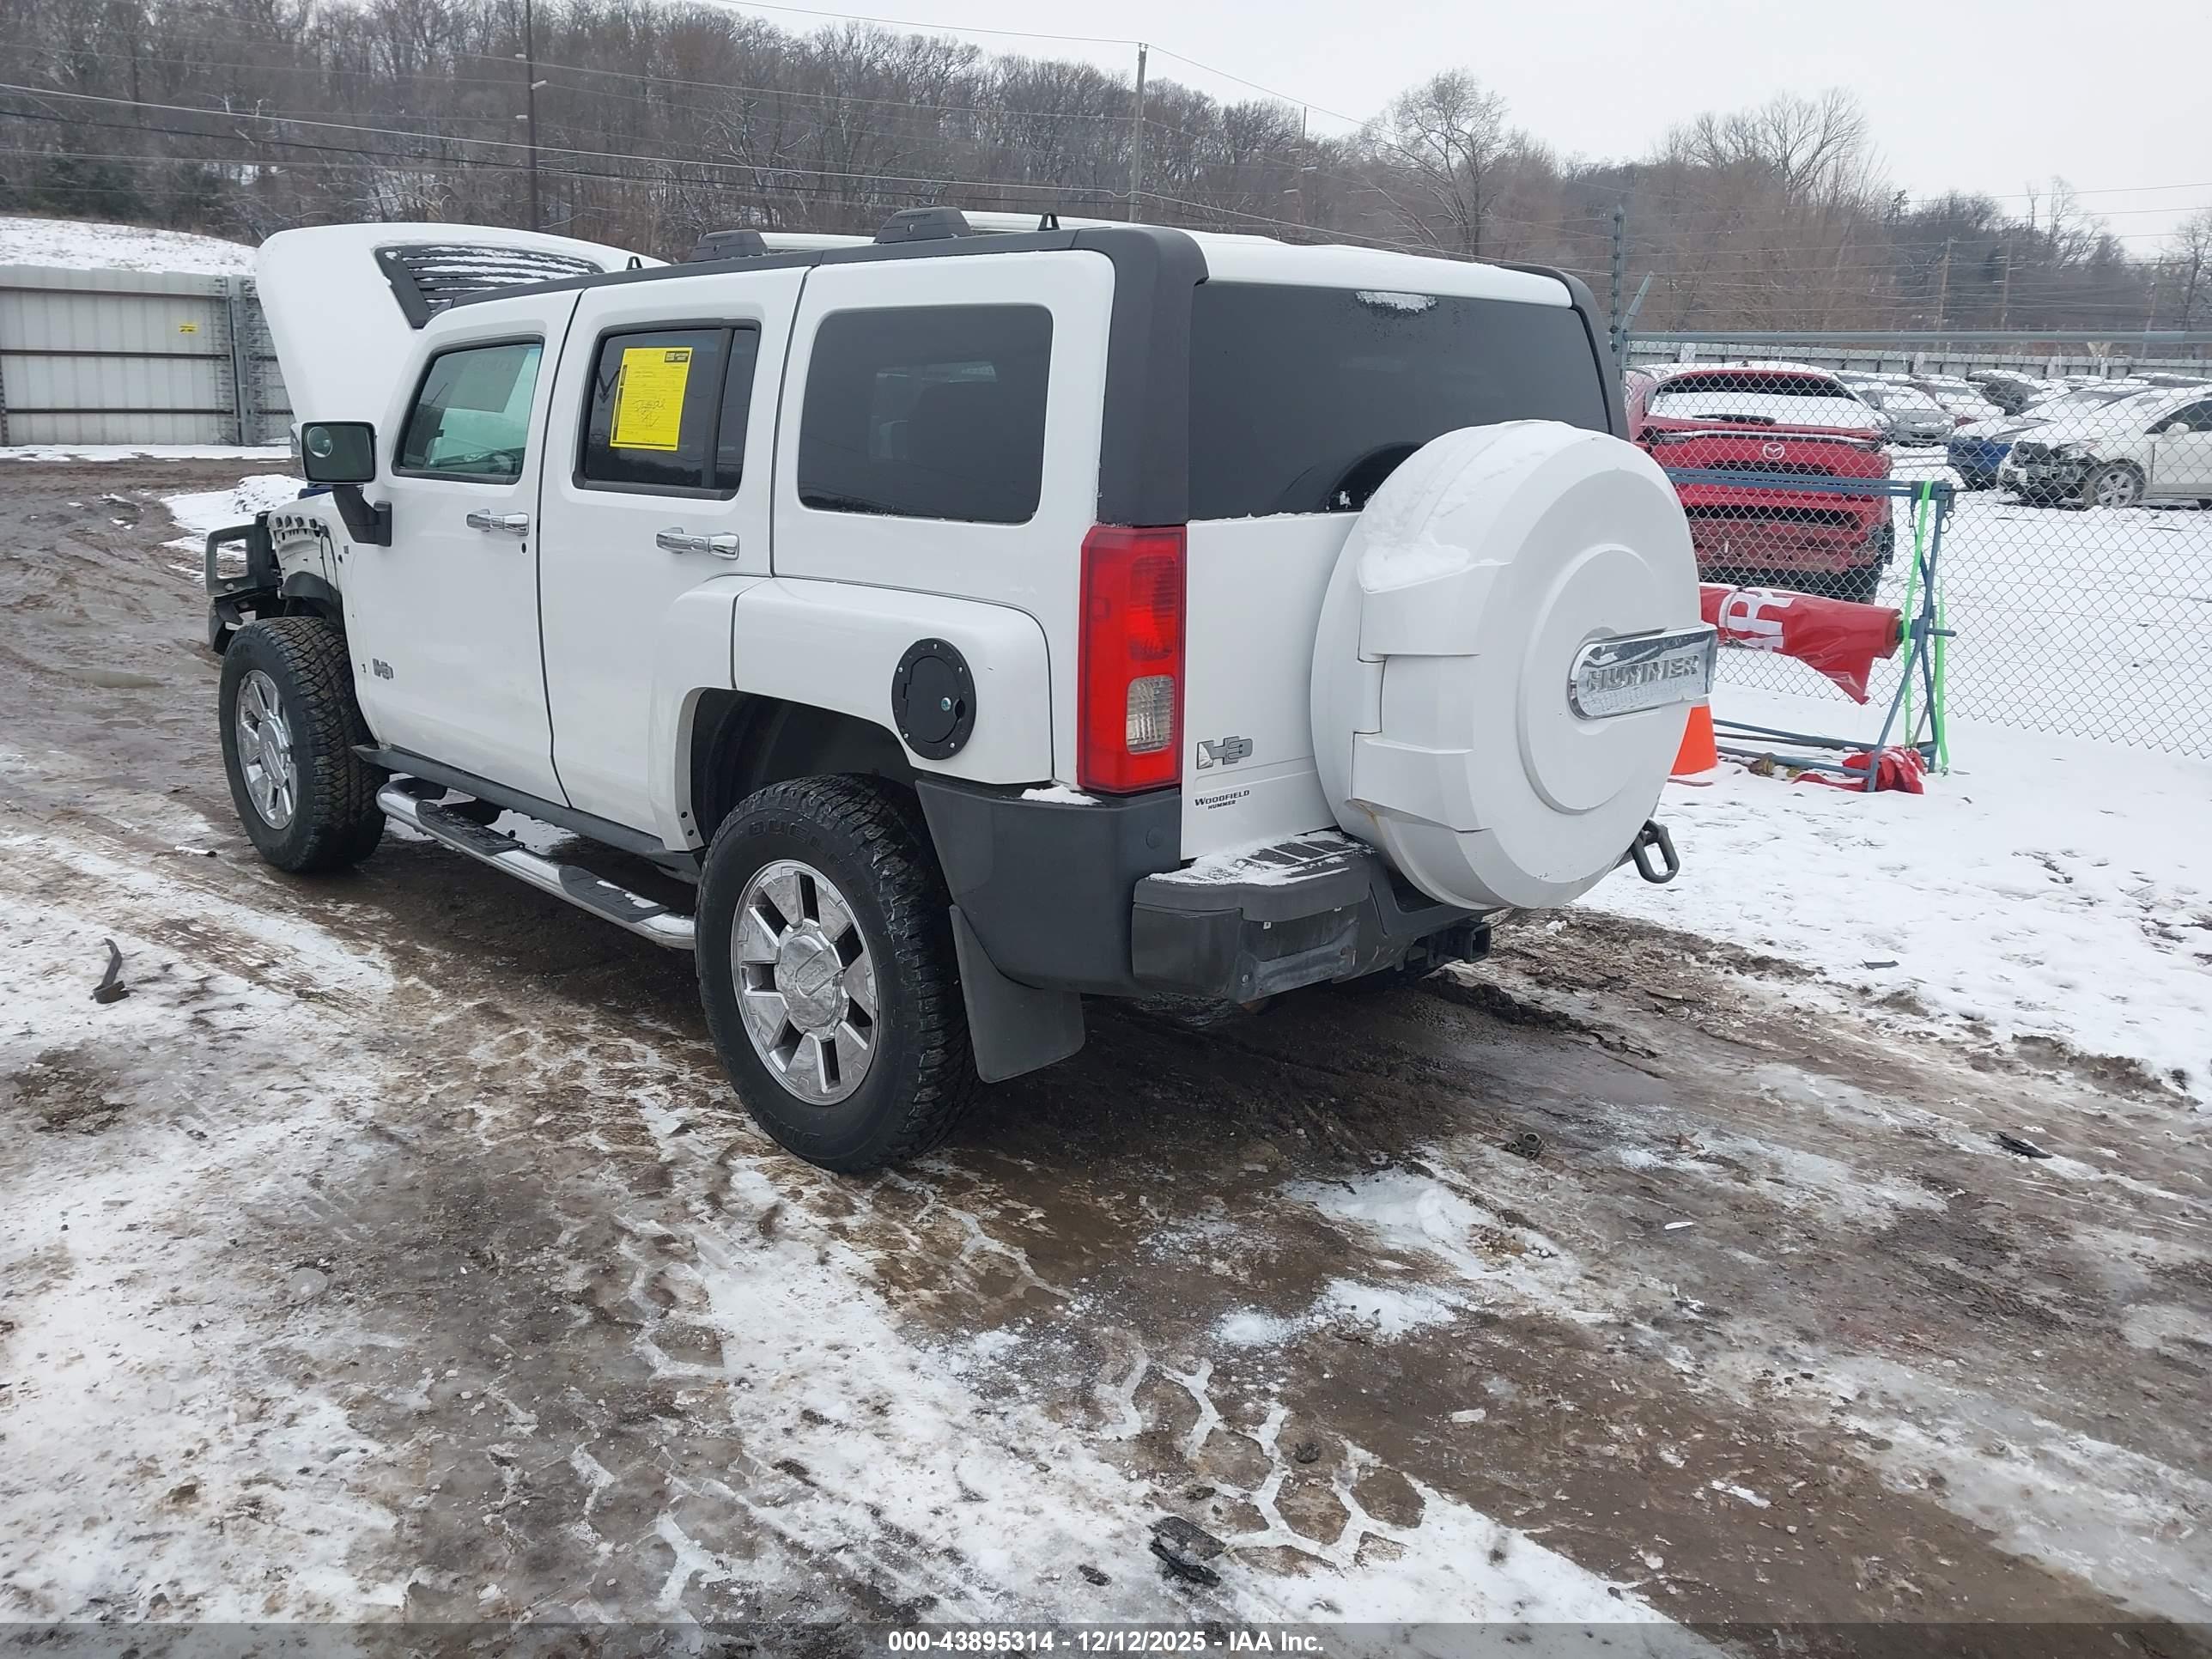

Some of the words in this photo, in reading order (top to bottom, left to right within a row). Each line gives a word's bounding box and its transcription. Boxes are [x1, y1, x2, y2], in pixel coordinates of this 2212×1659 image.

[1587, 655, 1699, 692] HUMMER
[1197, 736, 1253, 769] H3
[1207, 799, 1237, 810] HUMMER
